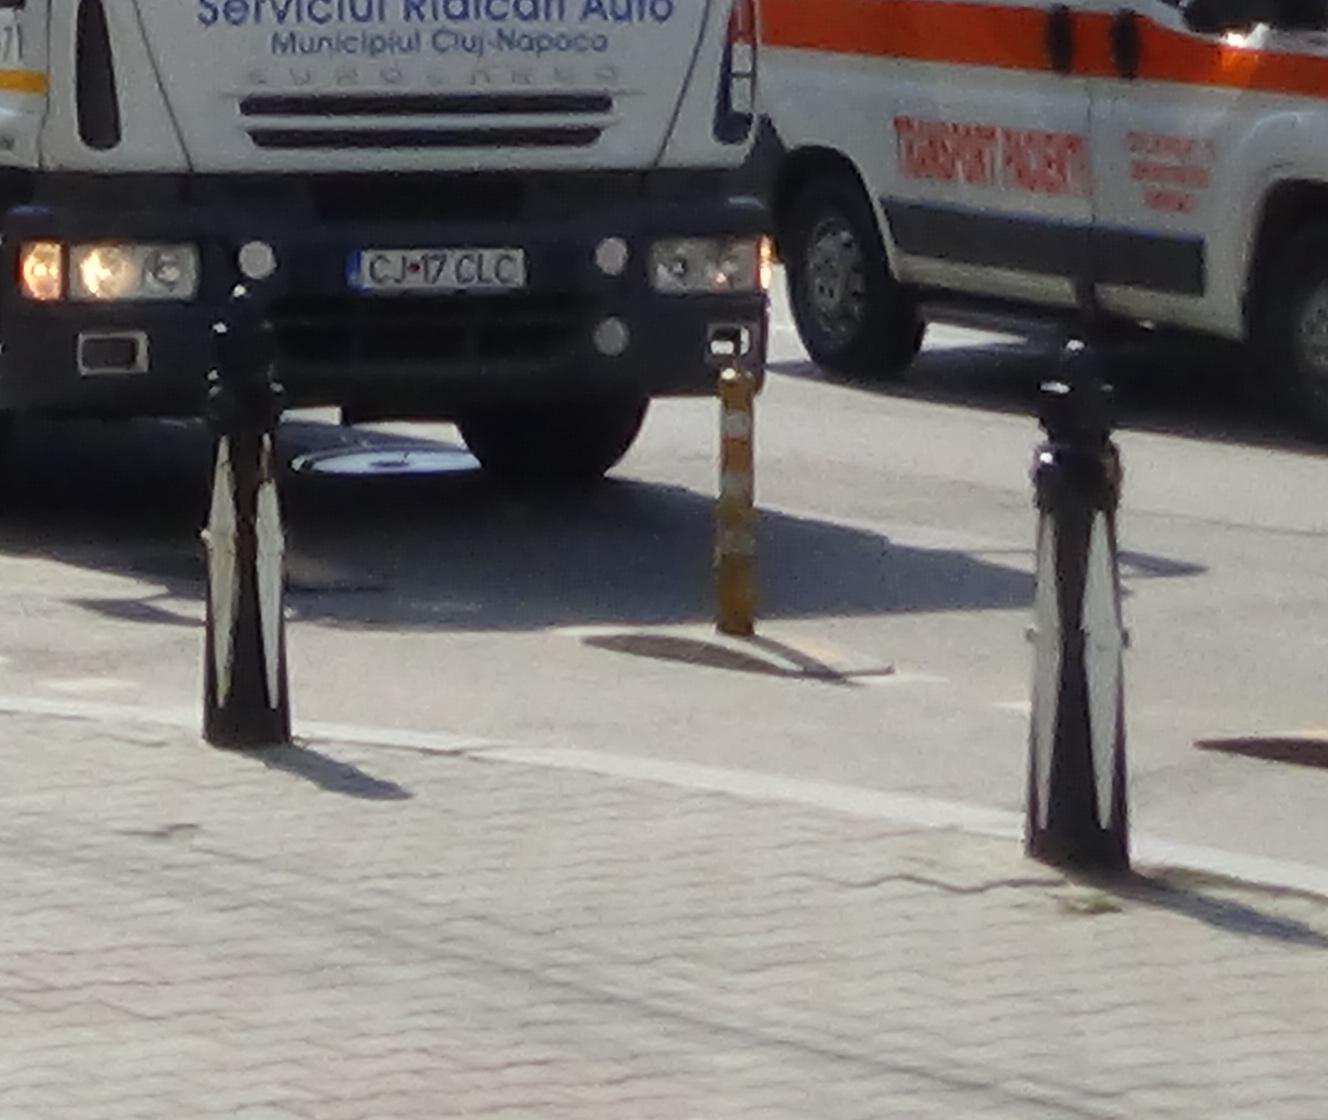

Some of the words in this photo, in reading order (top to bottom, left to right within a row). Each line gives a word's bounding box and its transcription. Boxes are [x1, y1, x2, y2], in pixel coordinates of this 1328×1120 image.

[270, 31, 422, 56] Municipiul
[431, 28, 609, 58] Cluj-Napoca
[369, 254, 407, 284] CJ
[420, 254, 447, 284] 17
[455, 254, 516, 284] CLC
